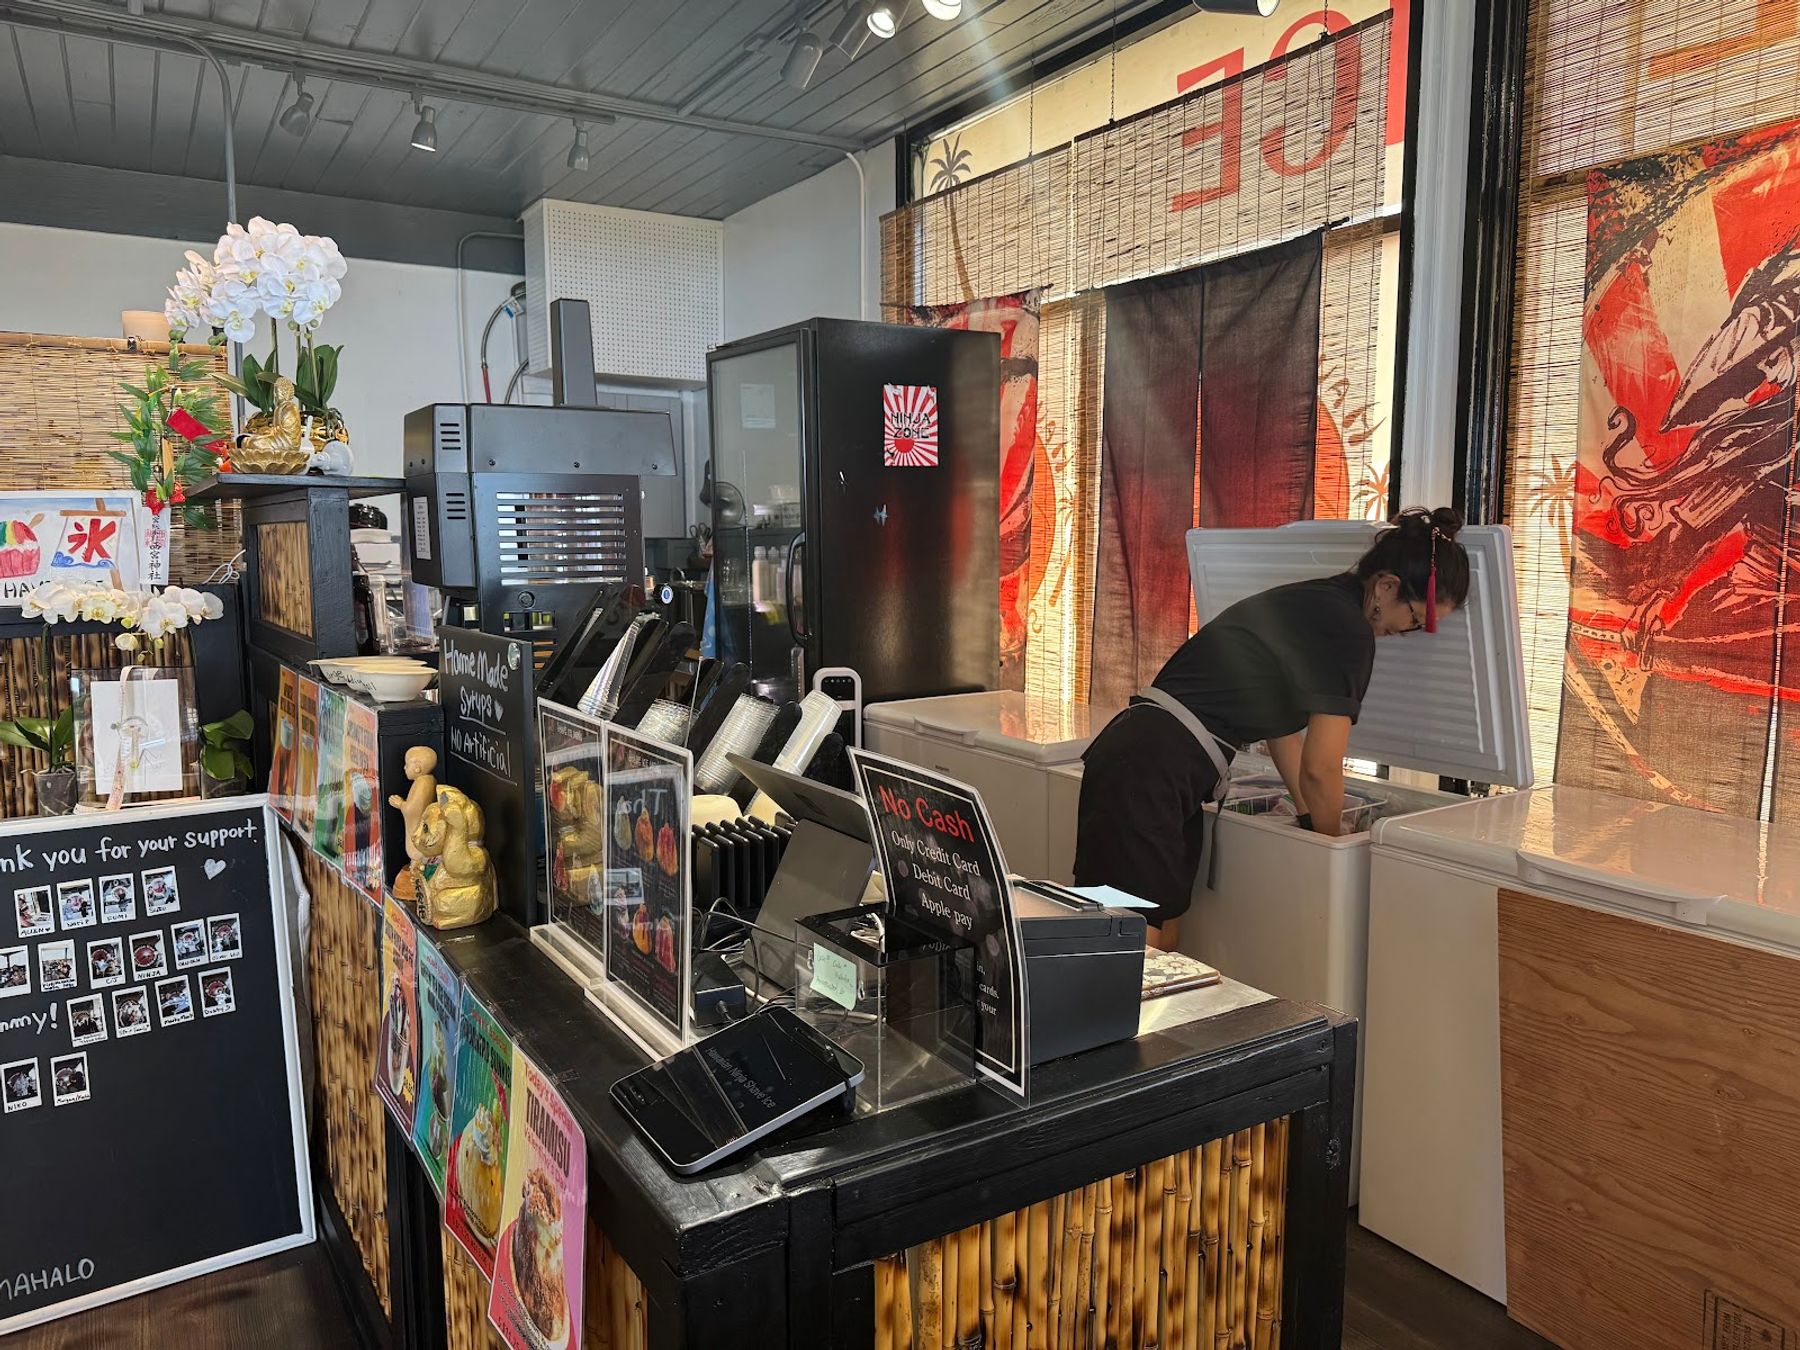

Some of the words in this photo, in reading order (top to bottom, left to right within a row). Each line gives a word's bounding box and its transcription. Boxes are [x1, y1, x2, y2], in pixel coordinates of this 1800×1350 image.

[890, 411, 930, 424] NINJA
[893, 427, 929, 439] ZONE
[67, 518, 117, 562] 氷
[443, 638, 476, 677] Home
[477, 649, 509, 692] Made
[460, 685, 492, 723] Syrups
[463, 732, 512, 778] Artificial
[879, 784, 912, 820] No
[915, 797, 976, 843] Cash
[42, 847, 87, 872] you
[95, 836, 131, 862] for
[138, 835, 177, 858] your
[891, 830, 915, 855] Only
[916, 839, 952, 866] Credit
[952, 852, 981, 877] Card
[912, 863, 943, 889] Debit
[943, 876, 971, 901] Card
[921, 892, 952, 918] Apple
[953, 910, 973, 931] pay
[980, 1002, 998, 1016] your
[743, 1080, 766, 1099] Shave
[761, 1095, 776, 1108] Ice
[526, 1087, 571, 1178] TIRAMISU
